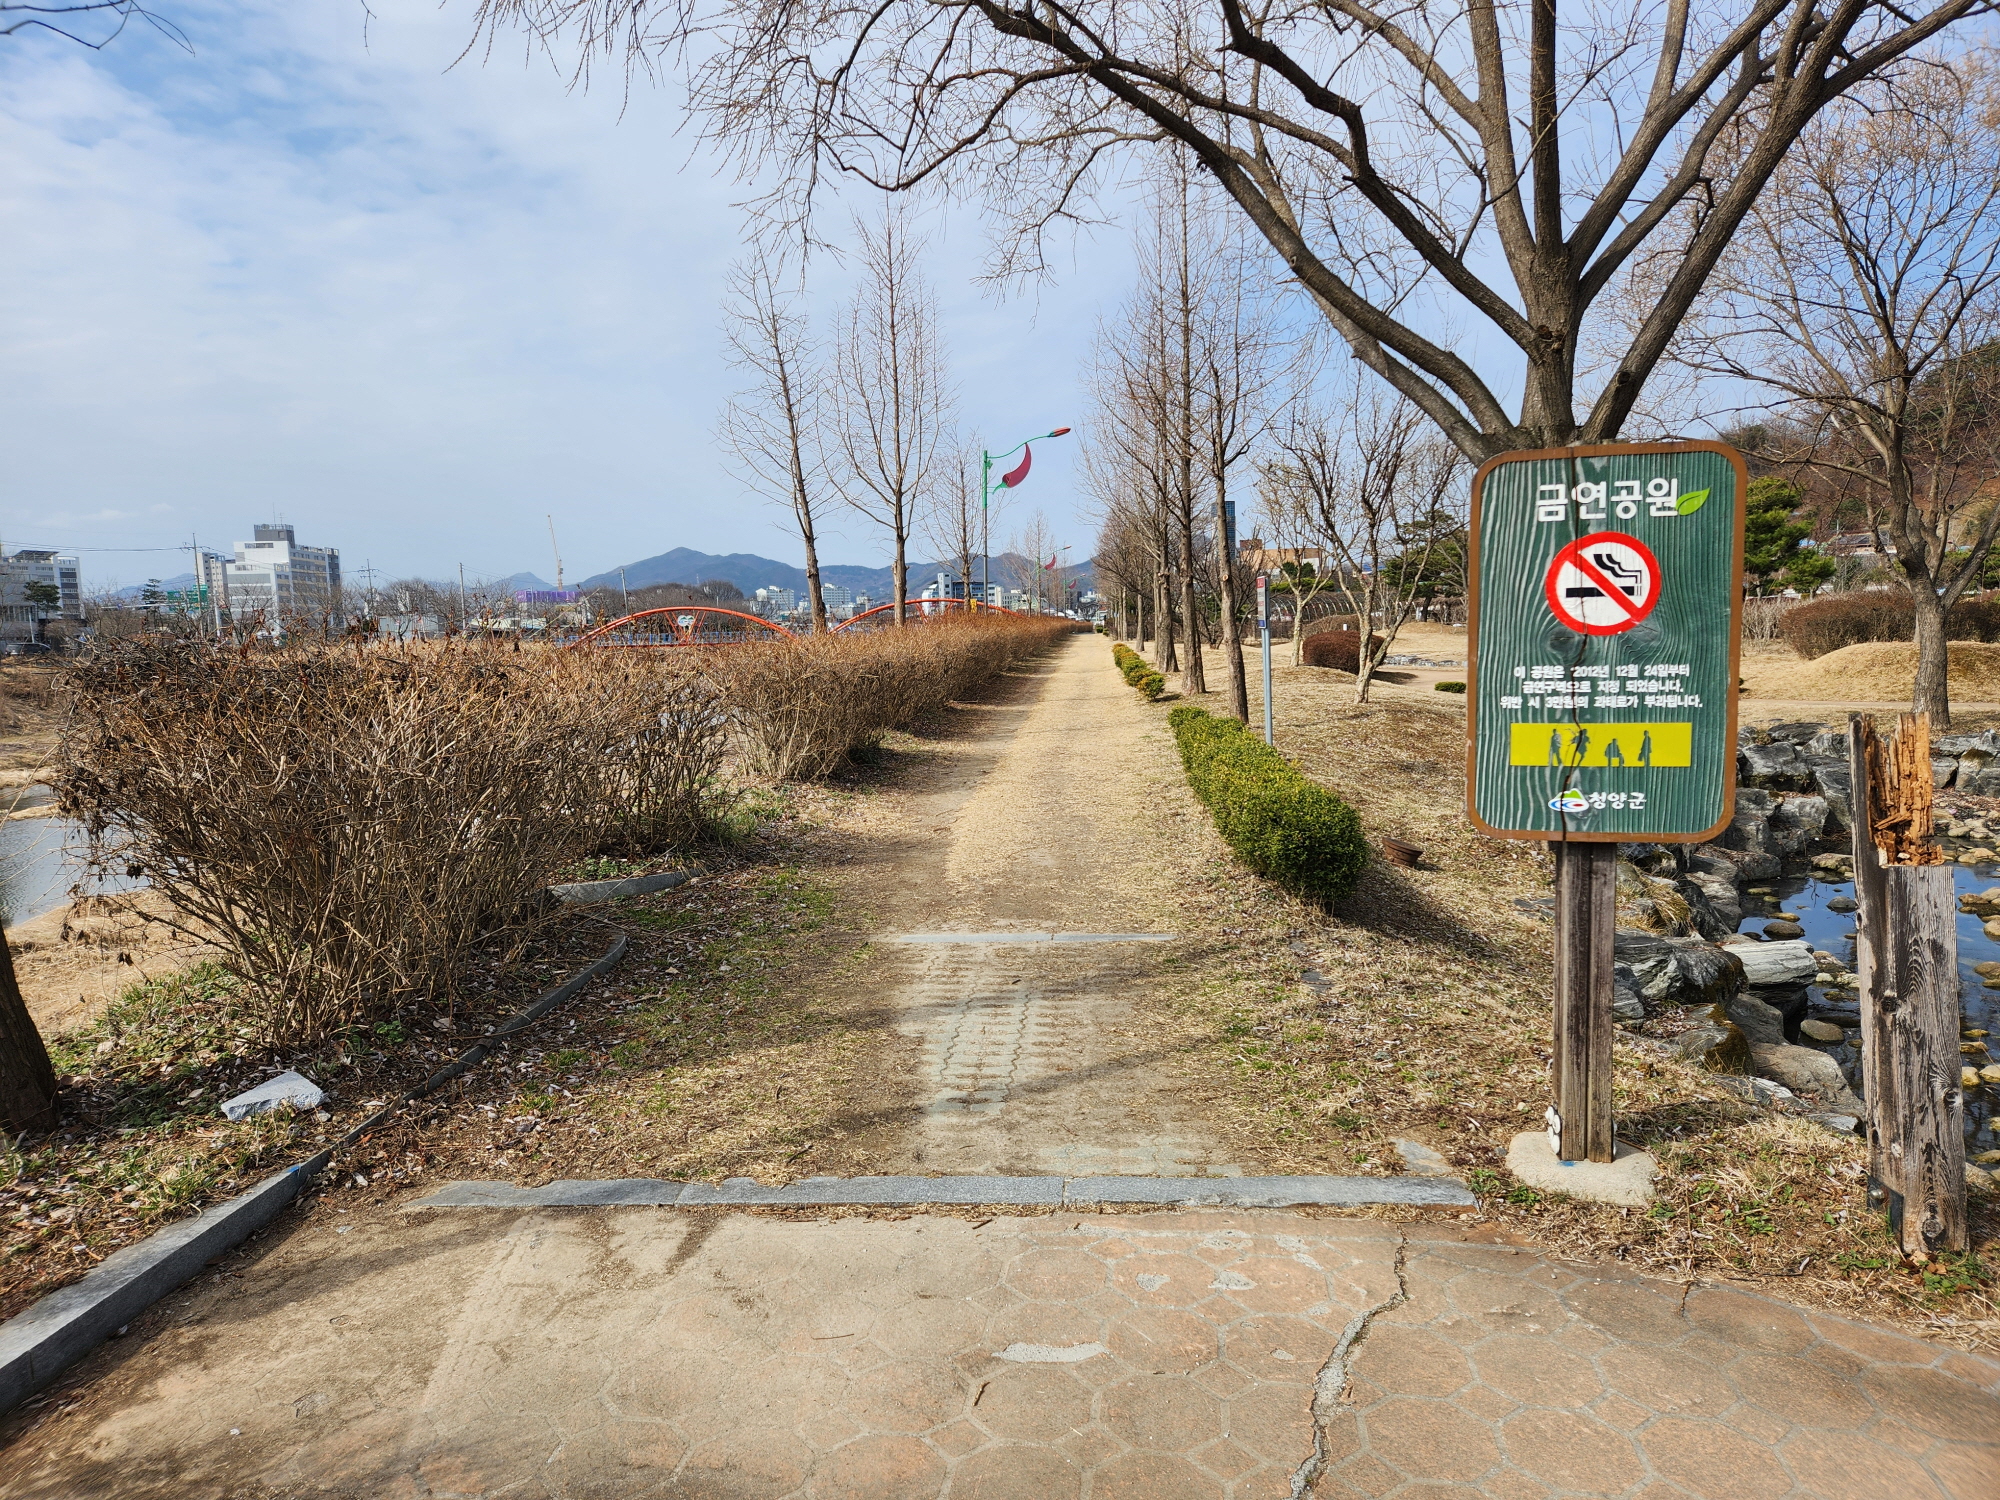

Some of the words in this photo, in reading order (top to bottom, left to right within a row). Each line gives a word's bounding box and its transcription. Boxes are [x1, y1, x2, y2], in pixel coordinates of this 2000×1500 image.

[1535, 477, 1678, 522] 금연공원
[1513, 665, 1526, 679] 이
[1531, 665, 1565, 679] 공원은
[1615, 664, 1639, 678] 12월
[1643, 663, 1690, 677] 24일부터
[1522, 680, 1592, 694] 금연구역으로
[1597, 679, 1620, 693] 지정
[1625, 679, 1684, 693] 되었습니다.
[1499, 695, 1523, 709] 위반
[1527, 695, 1541, 709] 시
[1544, 695, 1589, 709] 3만원의
[1593, 694, 1639, 708] 과태료가
[1644, 693, 1703, 708] 부과됩니다.
[1588, 791, 1647, 810] 청양군
